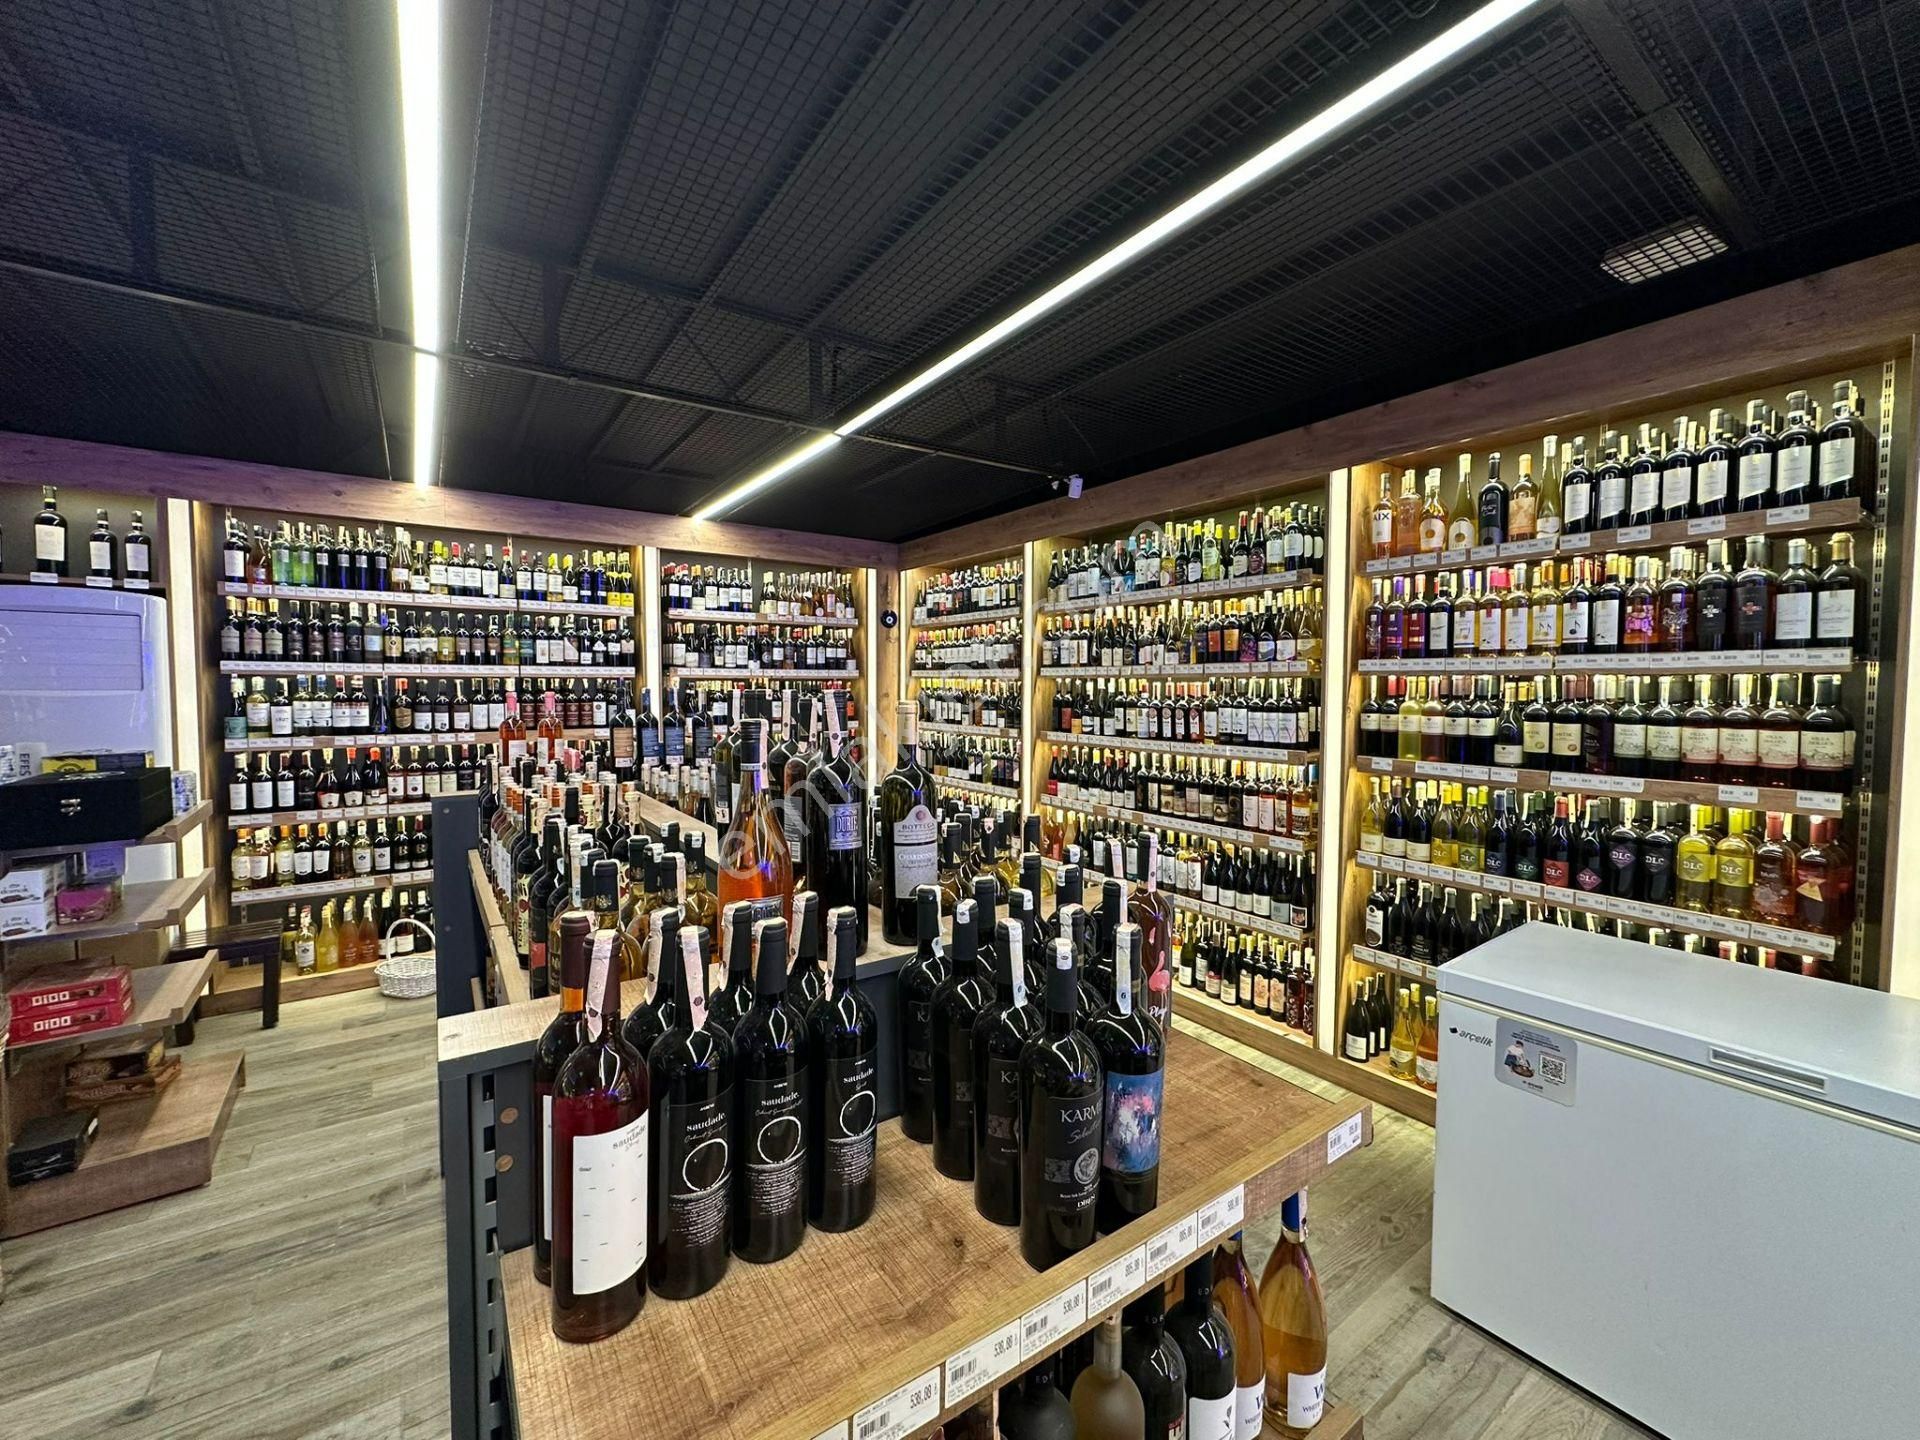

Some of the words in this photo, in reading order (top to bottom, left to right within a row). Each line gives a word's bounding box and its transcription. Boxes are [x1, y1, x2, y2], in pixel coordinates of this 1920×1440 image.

[19, 753, 31, 777] EFES
[1611, 851, 1631, 860] DLC
[1645, 855, 1664, 864] DLC
[1517, 863, 1534, 872] DLC
[1683, 861, 1703, 869] DLC
[1720, 865, 1742, 874] DLC
[1546, 868, 1563, 877] DLC
[1579, 874, 1597, 882] DLC
[1459, 1029, 1494, 1048] arçelik
